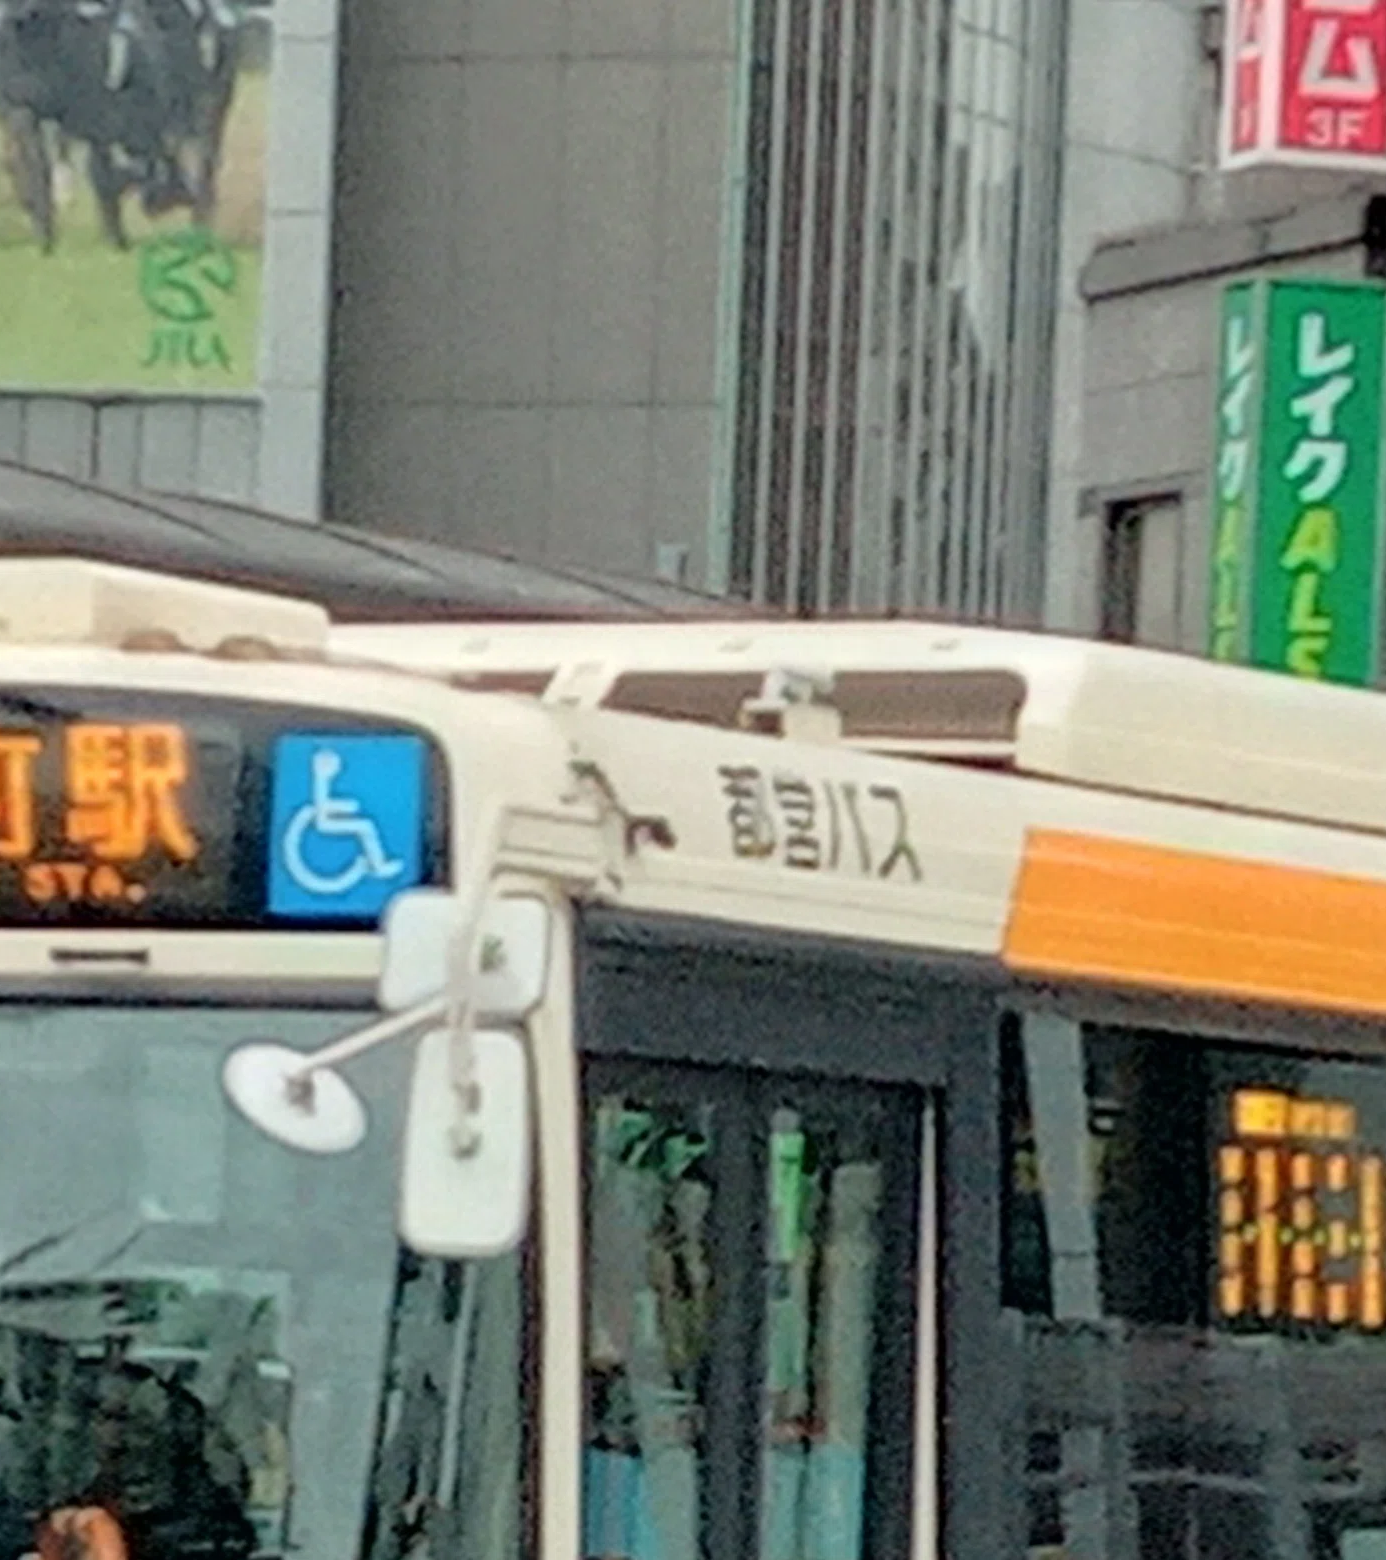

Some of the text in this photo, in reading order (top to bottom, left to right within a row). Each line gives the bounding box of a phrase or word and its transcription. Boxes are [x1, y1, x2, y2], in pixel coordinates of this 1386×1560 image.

[1299, 0, 1380, 100] ム
[1305, 108, 1367, 146] 3F
[716, 765, 923, 882] 都営バス
[24, 861, 147, 901] STA.
